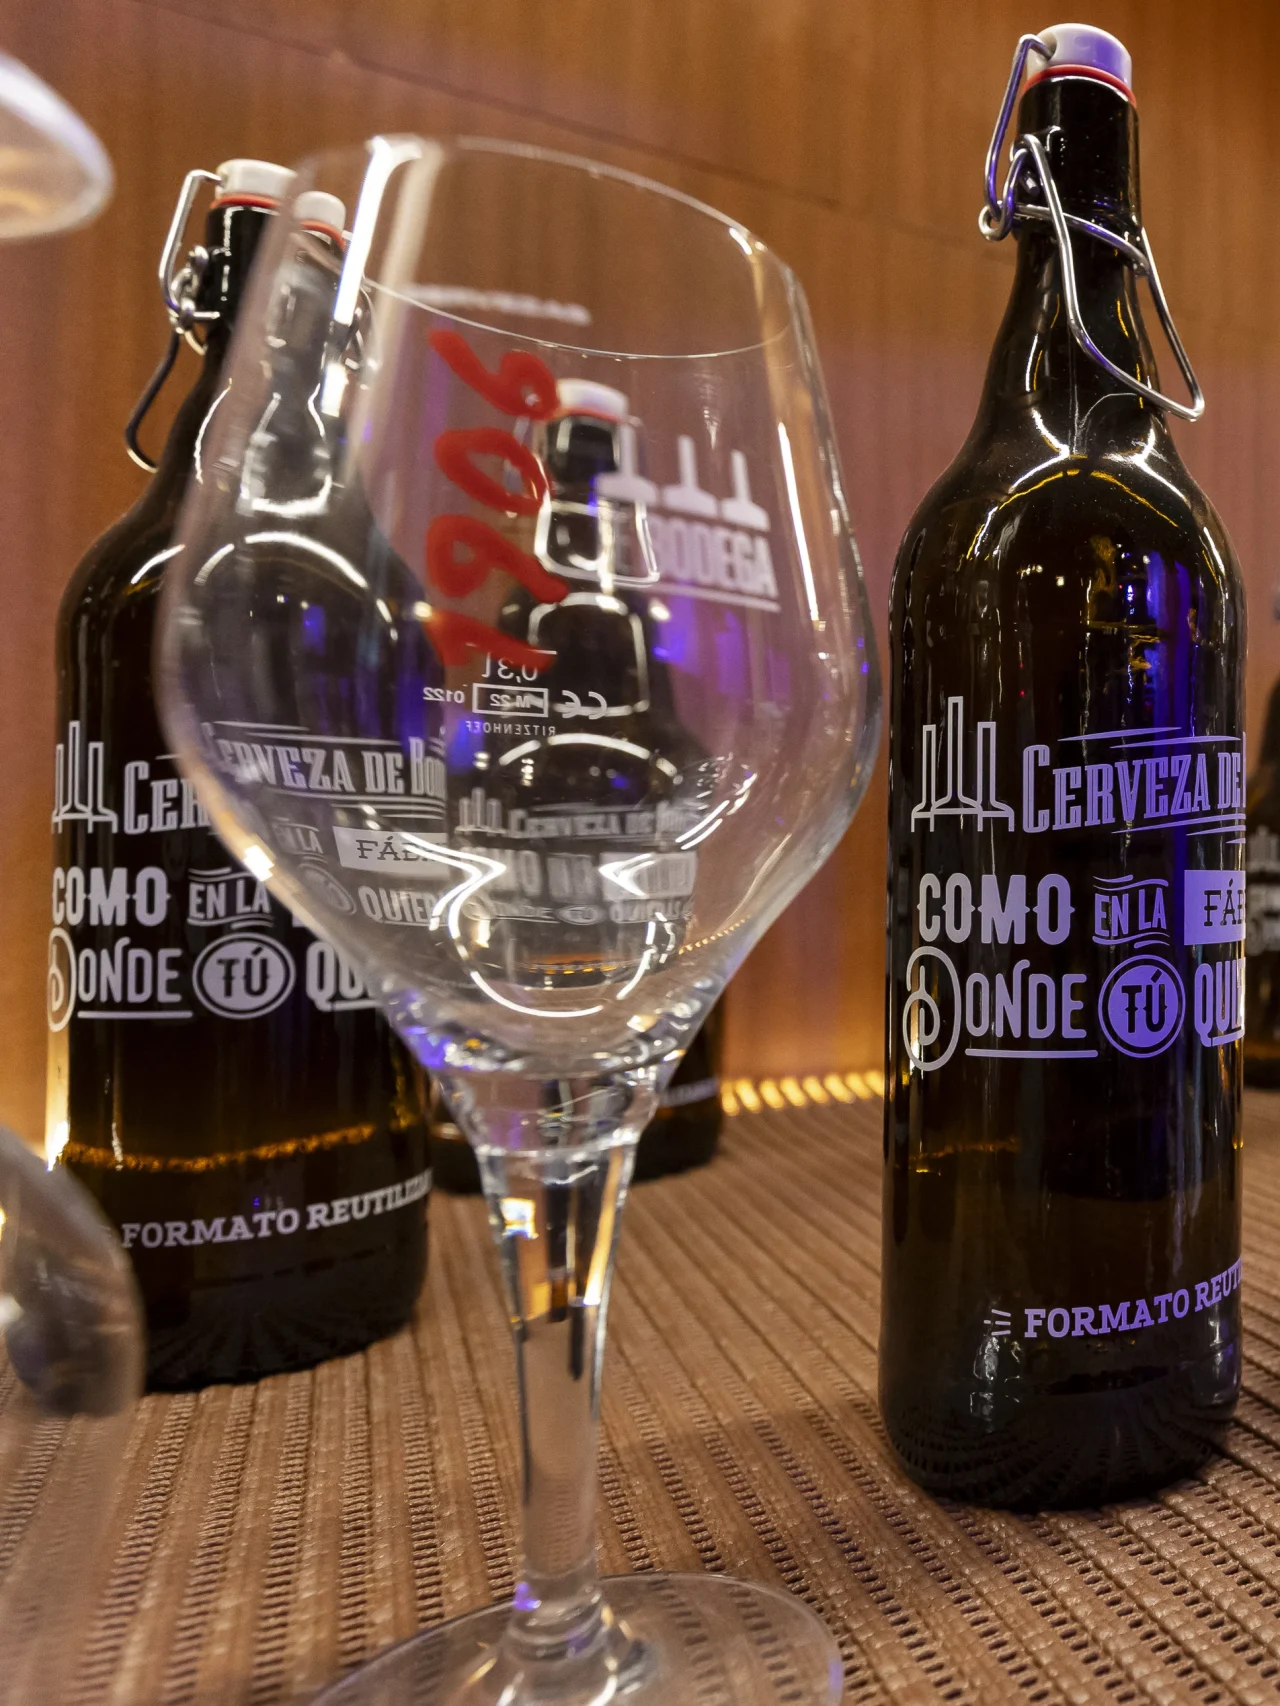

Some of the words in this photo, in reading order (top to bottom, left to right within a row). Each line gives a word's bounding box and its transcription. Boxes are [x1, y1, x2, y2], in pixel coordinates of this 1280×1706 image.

[362, 750, 405, 795] DE
[1022, 744, 1211, 833] CERVEZA
[1217, 752, 1241, 808] DE
[52, 866, 172, 926] COMO
[189, 881, 227, 919] EN
[236, 879, 271, 914] LA
[917, 873, 1075, 945] COMO
[1095, 893, 1129, 938] EN
[1138, 887, 1167, 931] LA
[47, 926, 183, 1032] DONDE
[903, 946, 1088, 1072] DONDE
[122, 1208, 300, 1249] FORMATO
[1024, 1288, 1190, 1338] FORMATO
